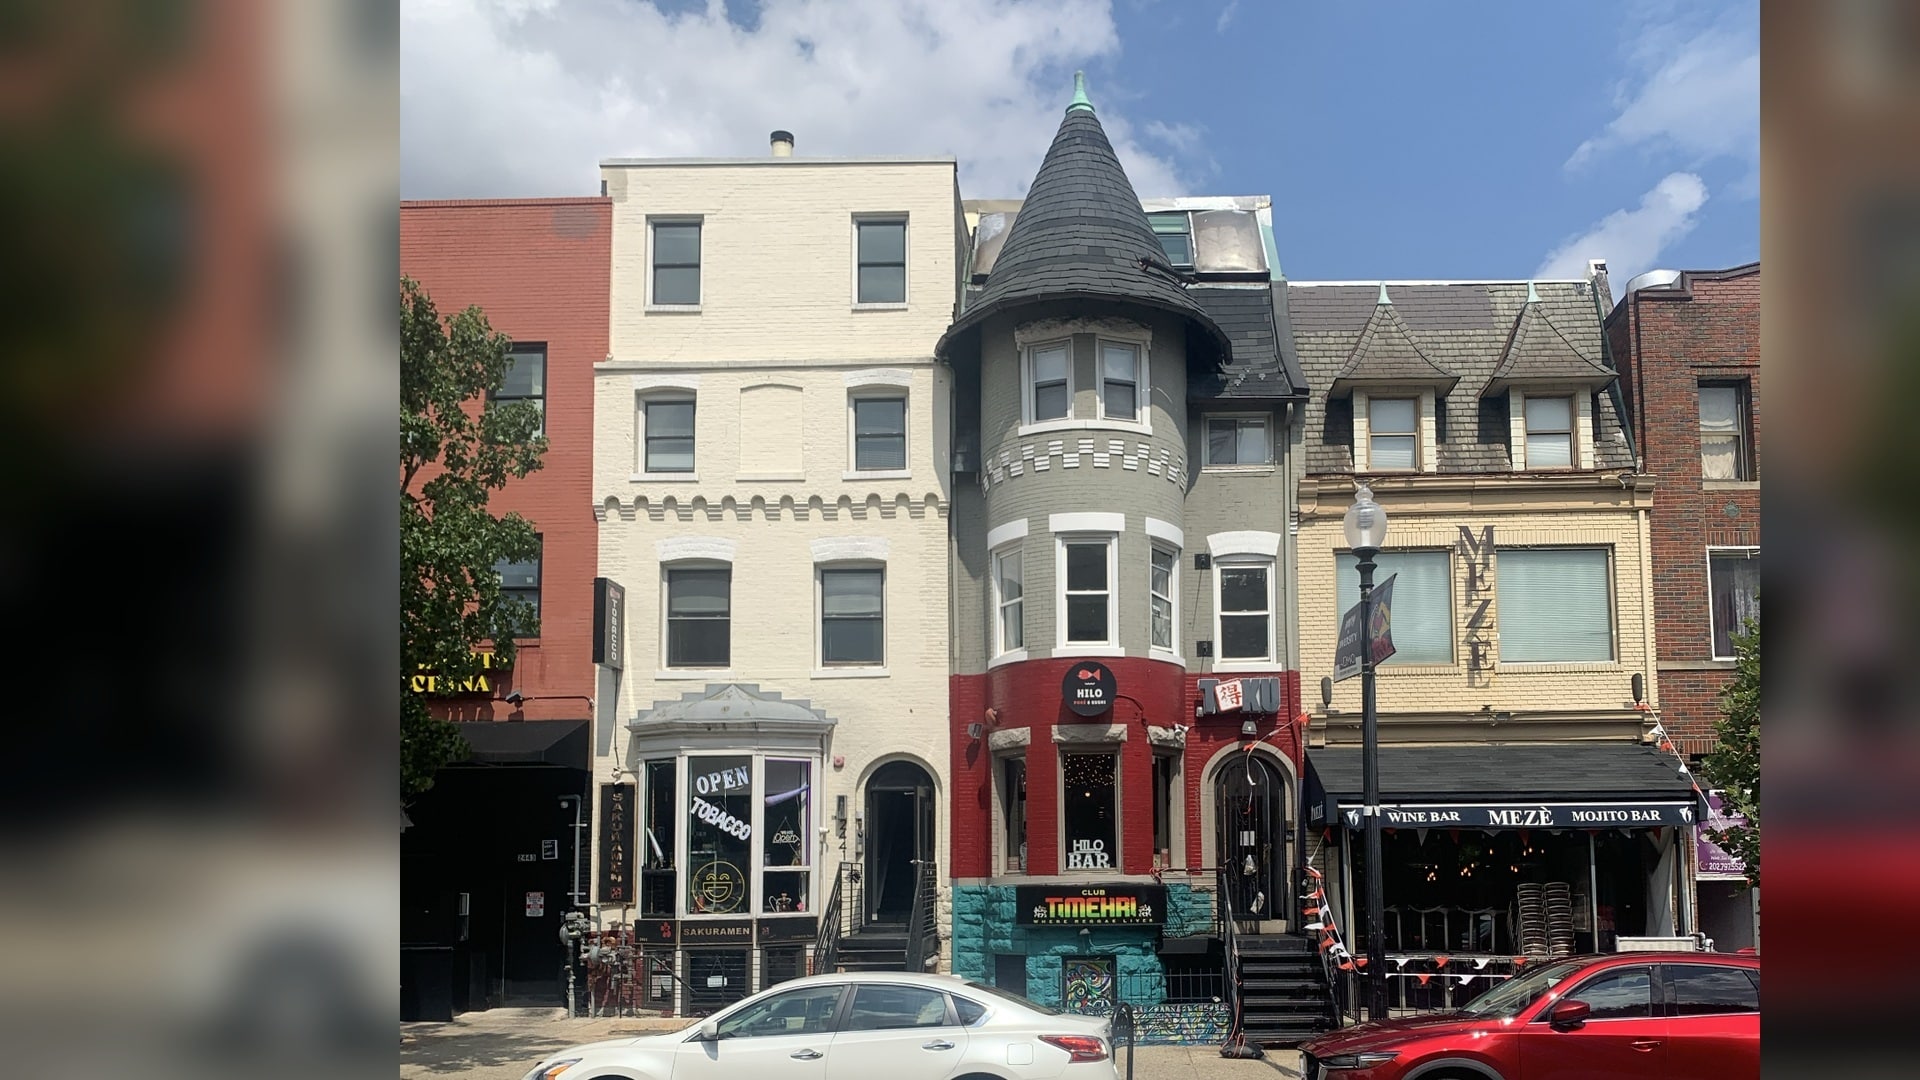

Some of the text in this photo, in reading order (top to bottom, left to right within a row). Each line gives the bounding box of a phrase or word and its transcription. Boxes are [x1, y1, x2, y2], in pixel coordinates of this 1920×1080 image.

[1077, 689, 1102, 698] HILO
[696, 765, 749, 794] OPEN
[690, 796, 752, 841] TOBACCO
[1387, 811, 1461, 823] WINE BAR
[1572, 810, 1662, 822] MOJITO BAR
[610, 792, 624, 883] SAKURAMEN
[838, 819, 847, 861] 2441
[1072, 839, 1104, 851] HILO
[1068, 852, 1110, 869] BAR
[683, 927, 750, 936] SAKURAMEN
